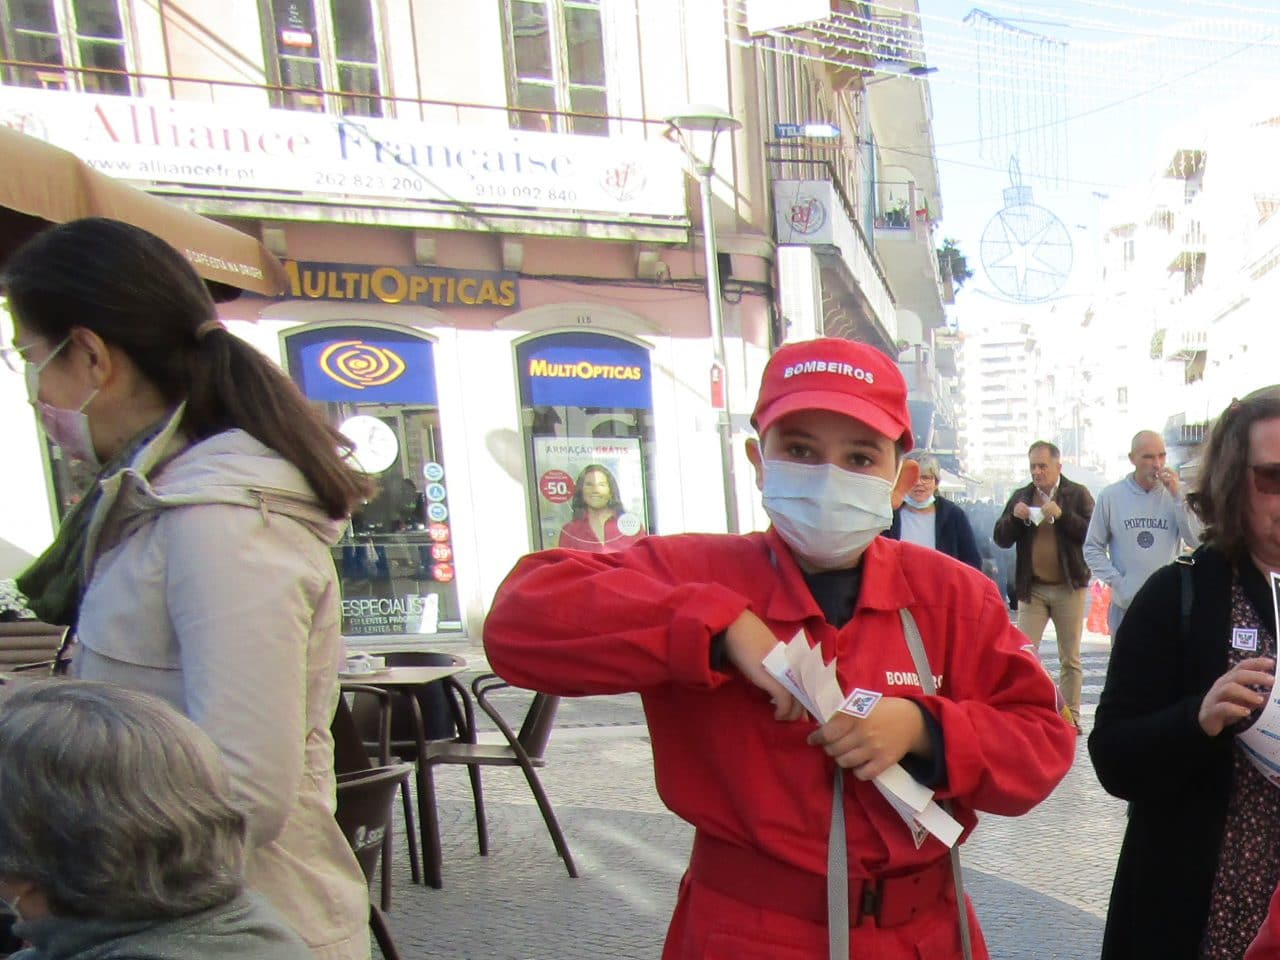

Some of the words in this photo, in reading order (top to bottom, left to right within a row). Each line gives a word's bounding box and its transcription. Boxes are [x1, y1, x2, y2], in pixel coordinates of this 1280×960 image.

[84, 102, 313, 154] Alliance
[335, 121, 577, 181] Française
[315, 171, 346, 187] 262
[354, 174, 385, 189] 823
[392, 177, 423, 193] 200
[512, 187, 542, 200] 092
[548, 189, 578, 202] 840
[784, 360, 875, 384] BOMBEIROS
[1123, 518, 1169, 530] PORTUGAL
